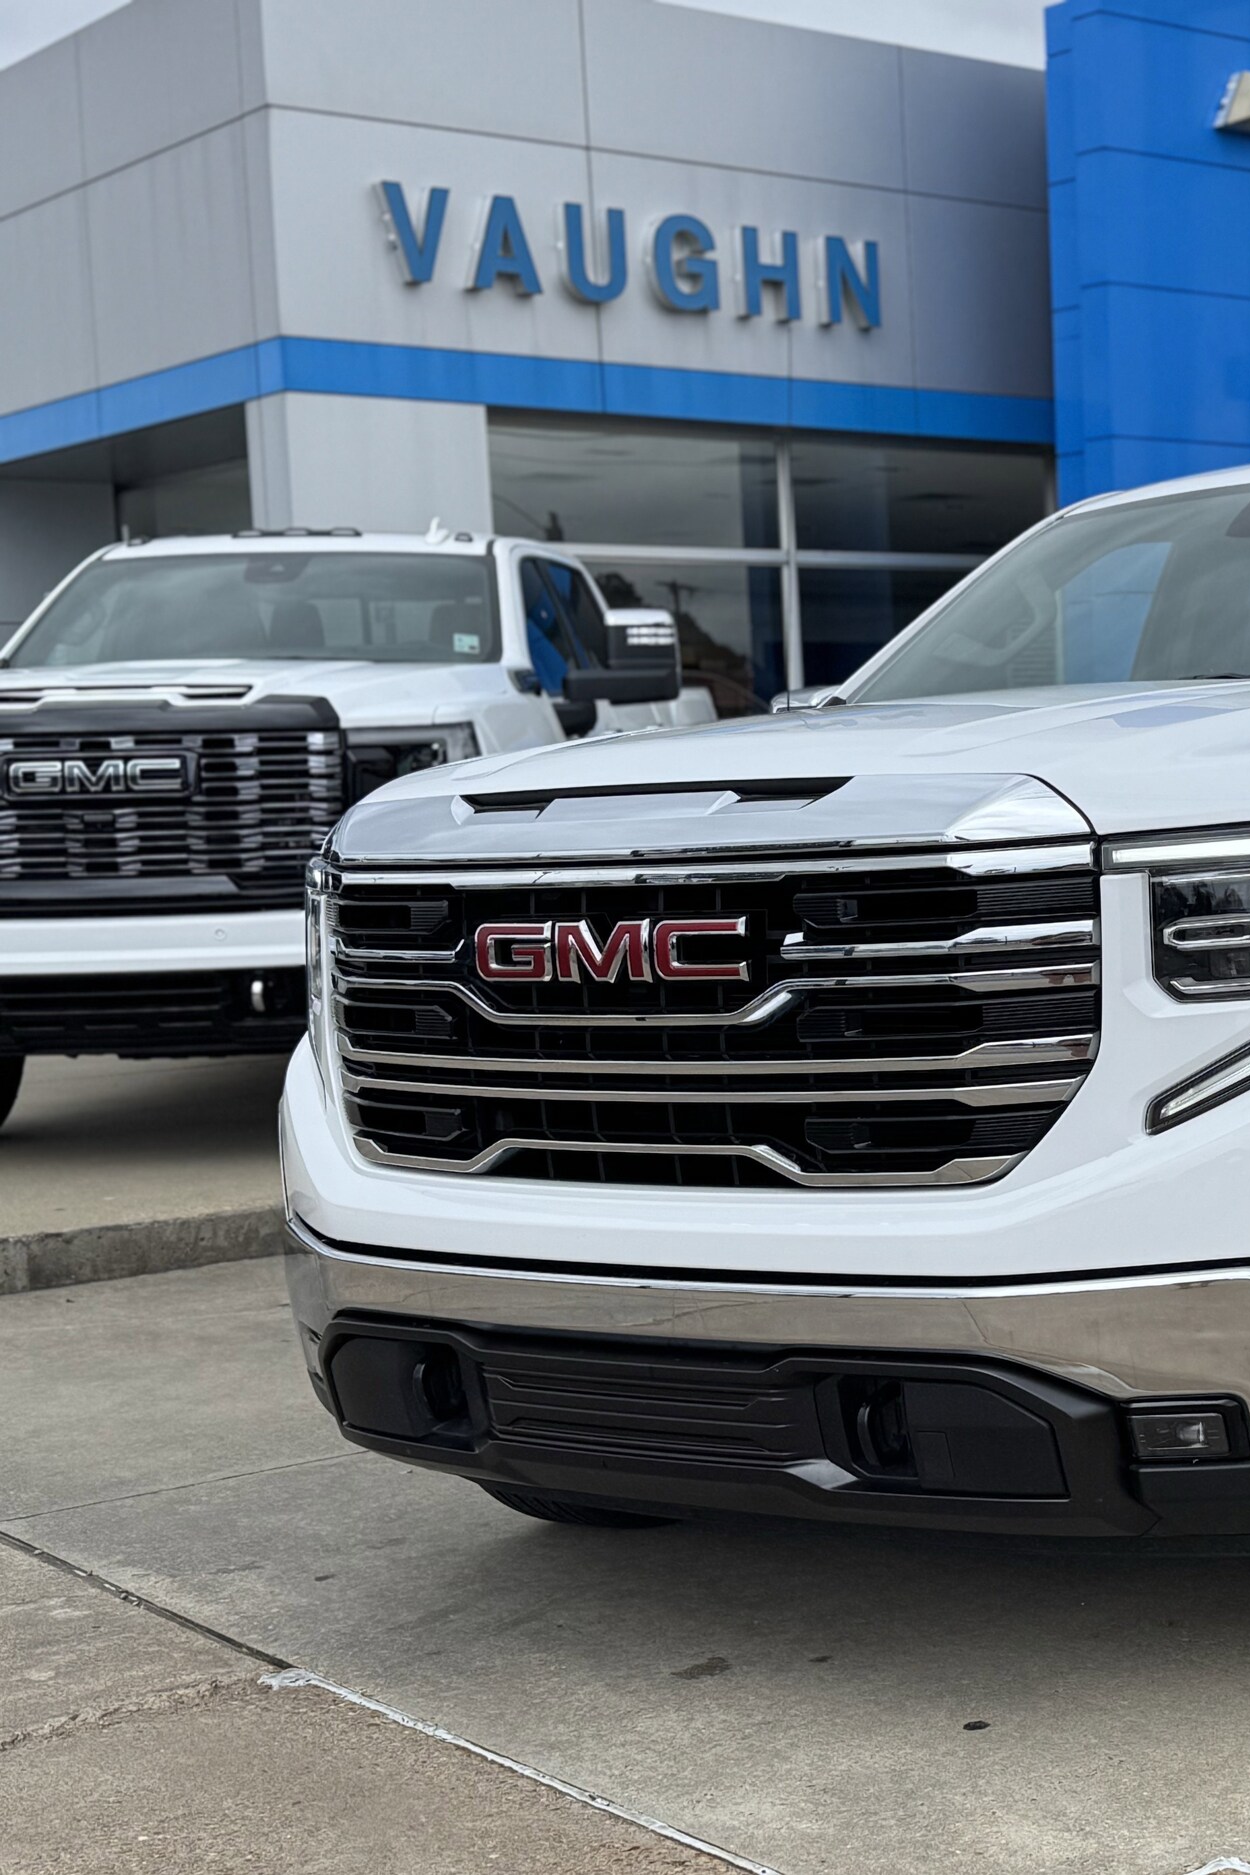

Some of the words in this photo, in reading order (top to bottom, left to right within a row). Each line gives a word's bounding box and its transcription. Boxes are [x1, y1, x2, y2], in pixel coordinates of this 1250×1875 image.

[376, 180, 882, 329] VAUGHN
[9, 758, 182, 793] GMC
[475, 917, 750, 983] GMC
